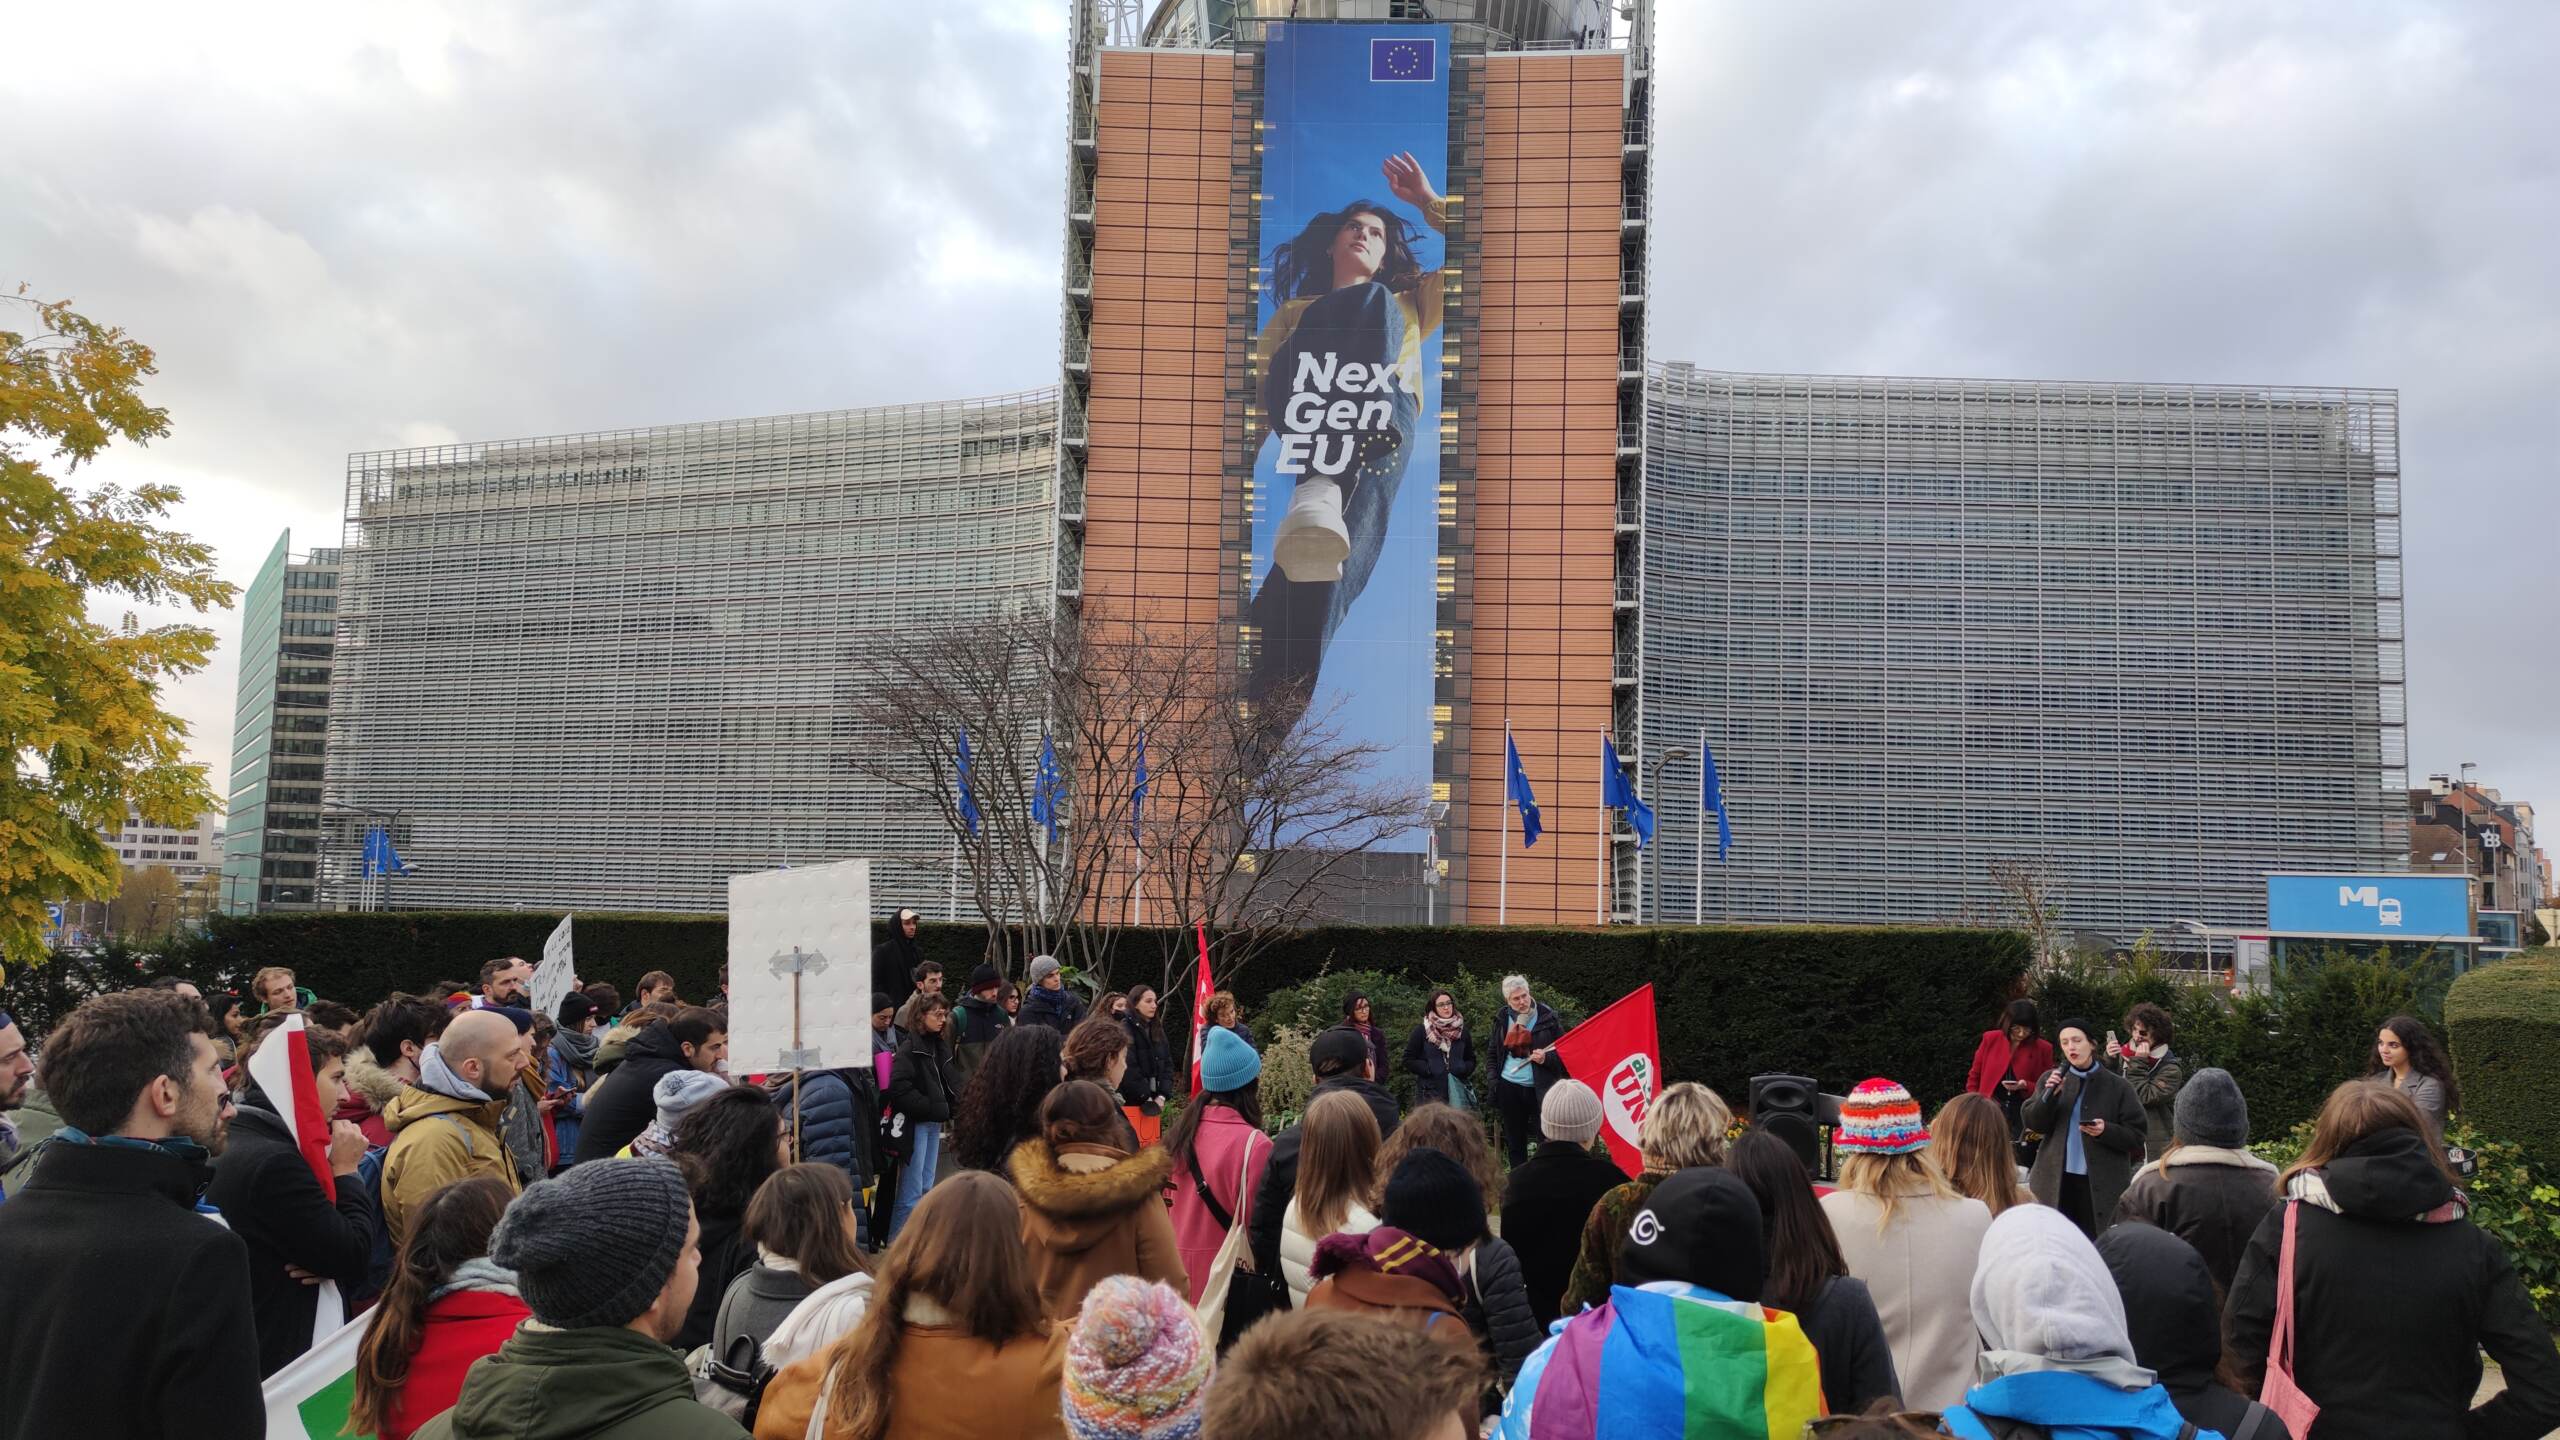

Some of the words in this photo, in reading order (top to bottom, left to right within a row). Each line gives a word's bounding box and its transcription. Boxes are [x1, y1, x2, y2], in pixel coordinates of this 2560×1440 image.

[1292, 351, 1418, 393] Next
[1284, 391, 1393, 433] Gen
[1275, 433, 1356, 475] EU
[1611, 1064, 1647, 1134] UN
